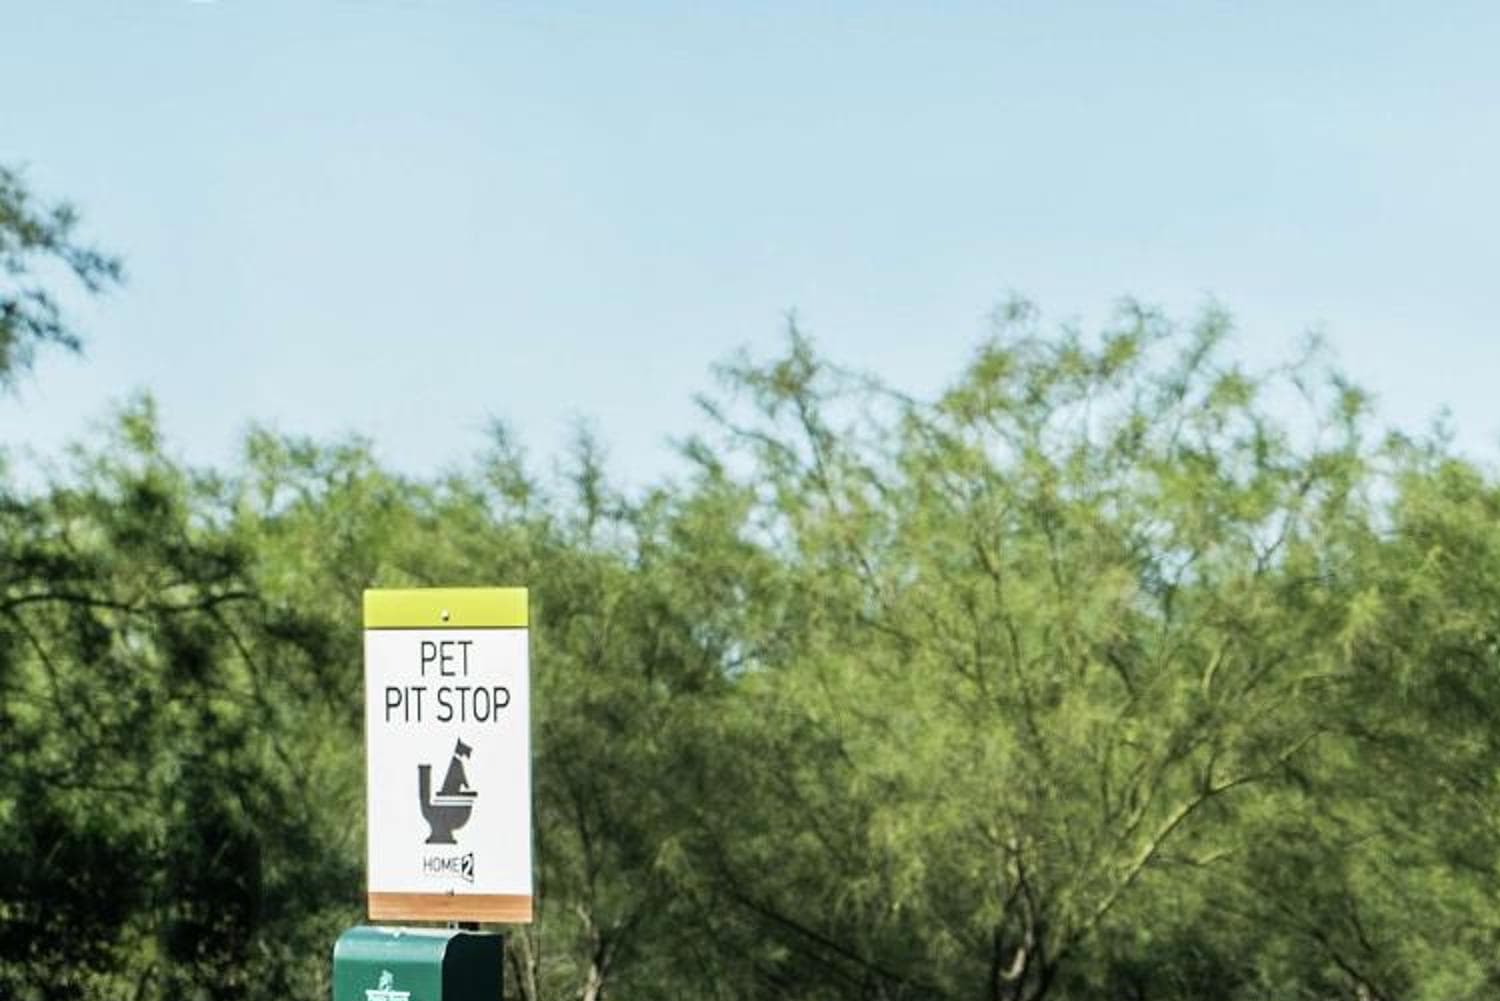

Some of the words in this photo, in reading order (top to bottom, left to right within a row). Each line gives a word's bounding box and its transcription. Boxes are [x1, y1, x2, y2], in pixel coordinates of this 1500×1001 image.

[420, 640, 473, 677] PET
[385, 686, 427, 723] PIT
[436, 686, 511, 723] STOP
